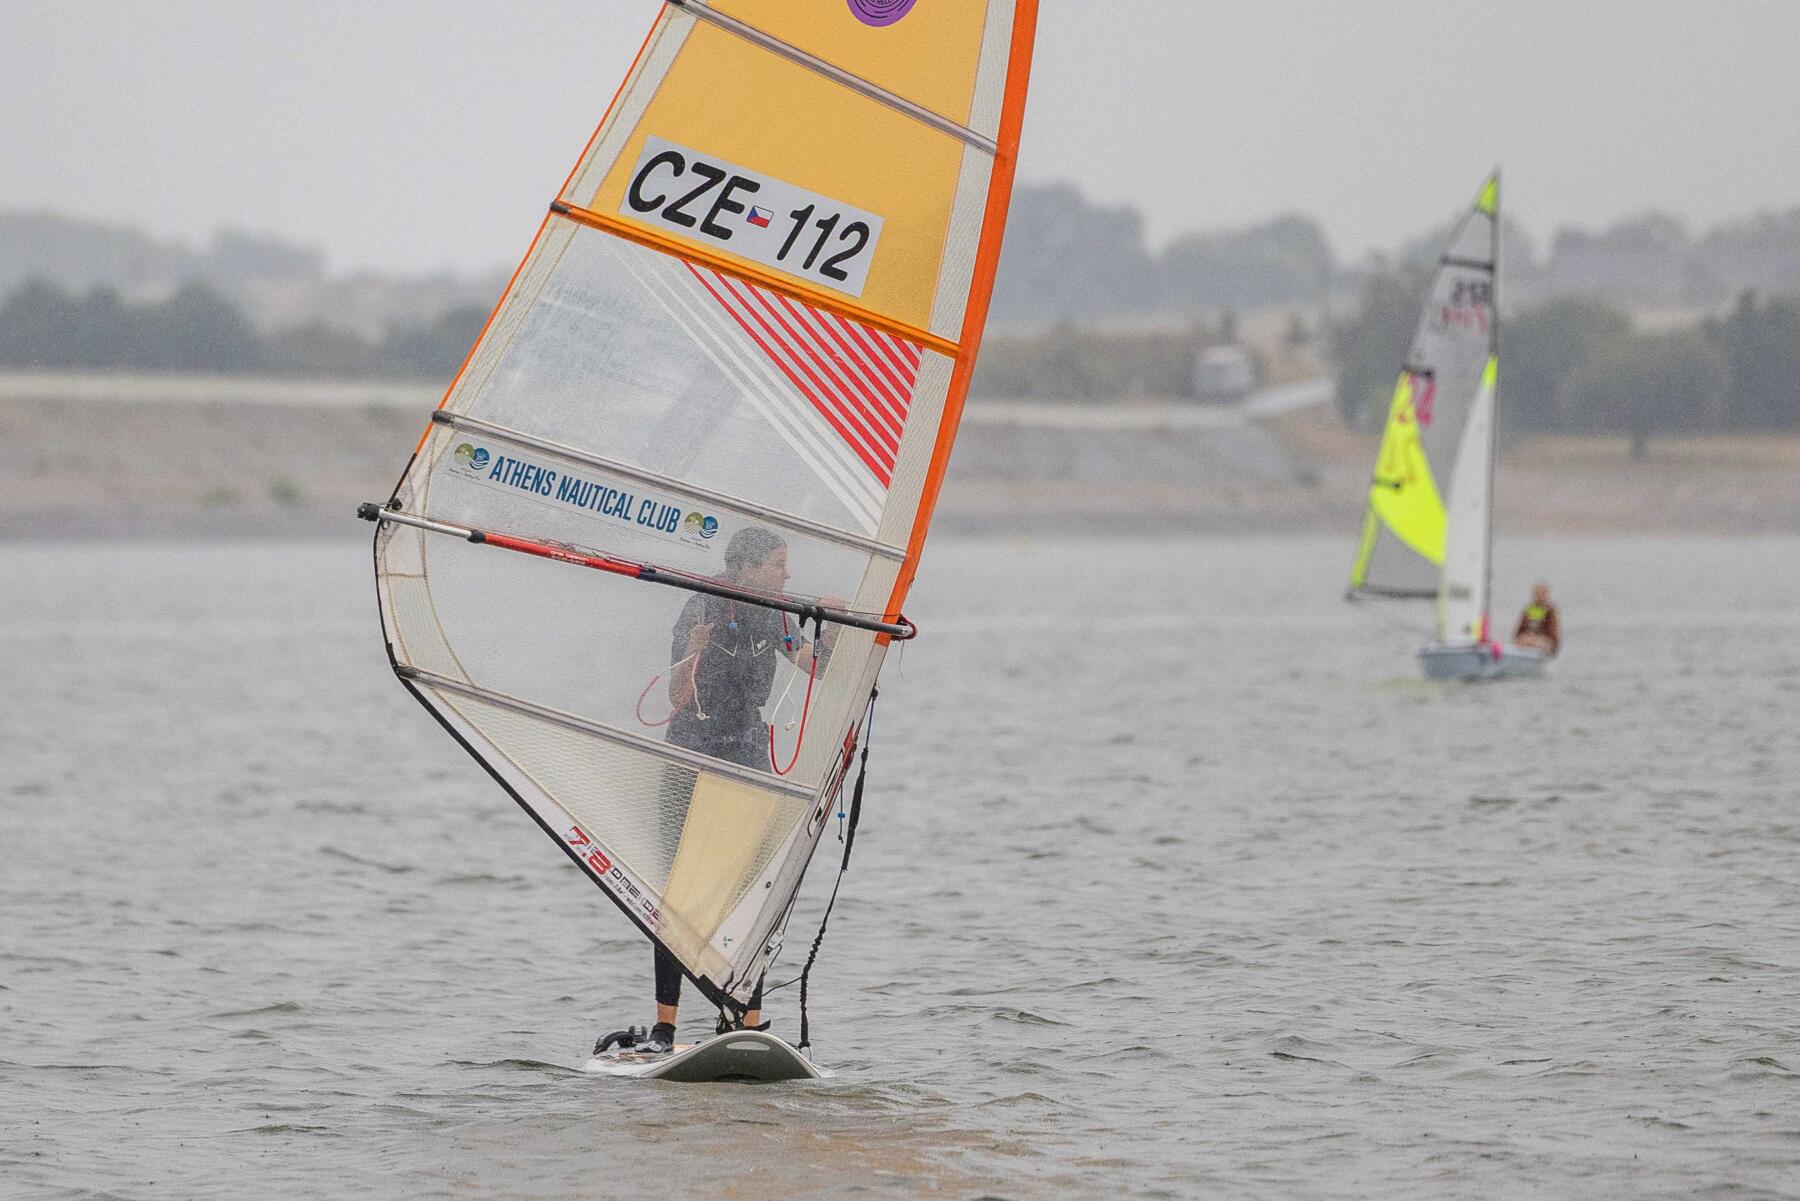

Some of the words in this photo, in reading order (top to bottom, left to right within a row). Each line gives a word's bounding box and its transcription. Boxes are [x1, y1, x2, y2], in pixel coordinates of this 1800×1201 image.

[628, 150, 761, 240] CZE
[776, 203, 871, 282] 112
[488, 455, 556, 497] ATHENS
[556, 476, 634, 521] NAUTICAL
[637, 499, 682, 534] CLUB
[568, 825, 612, 876] 7.8
